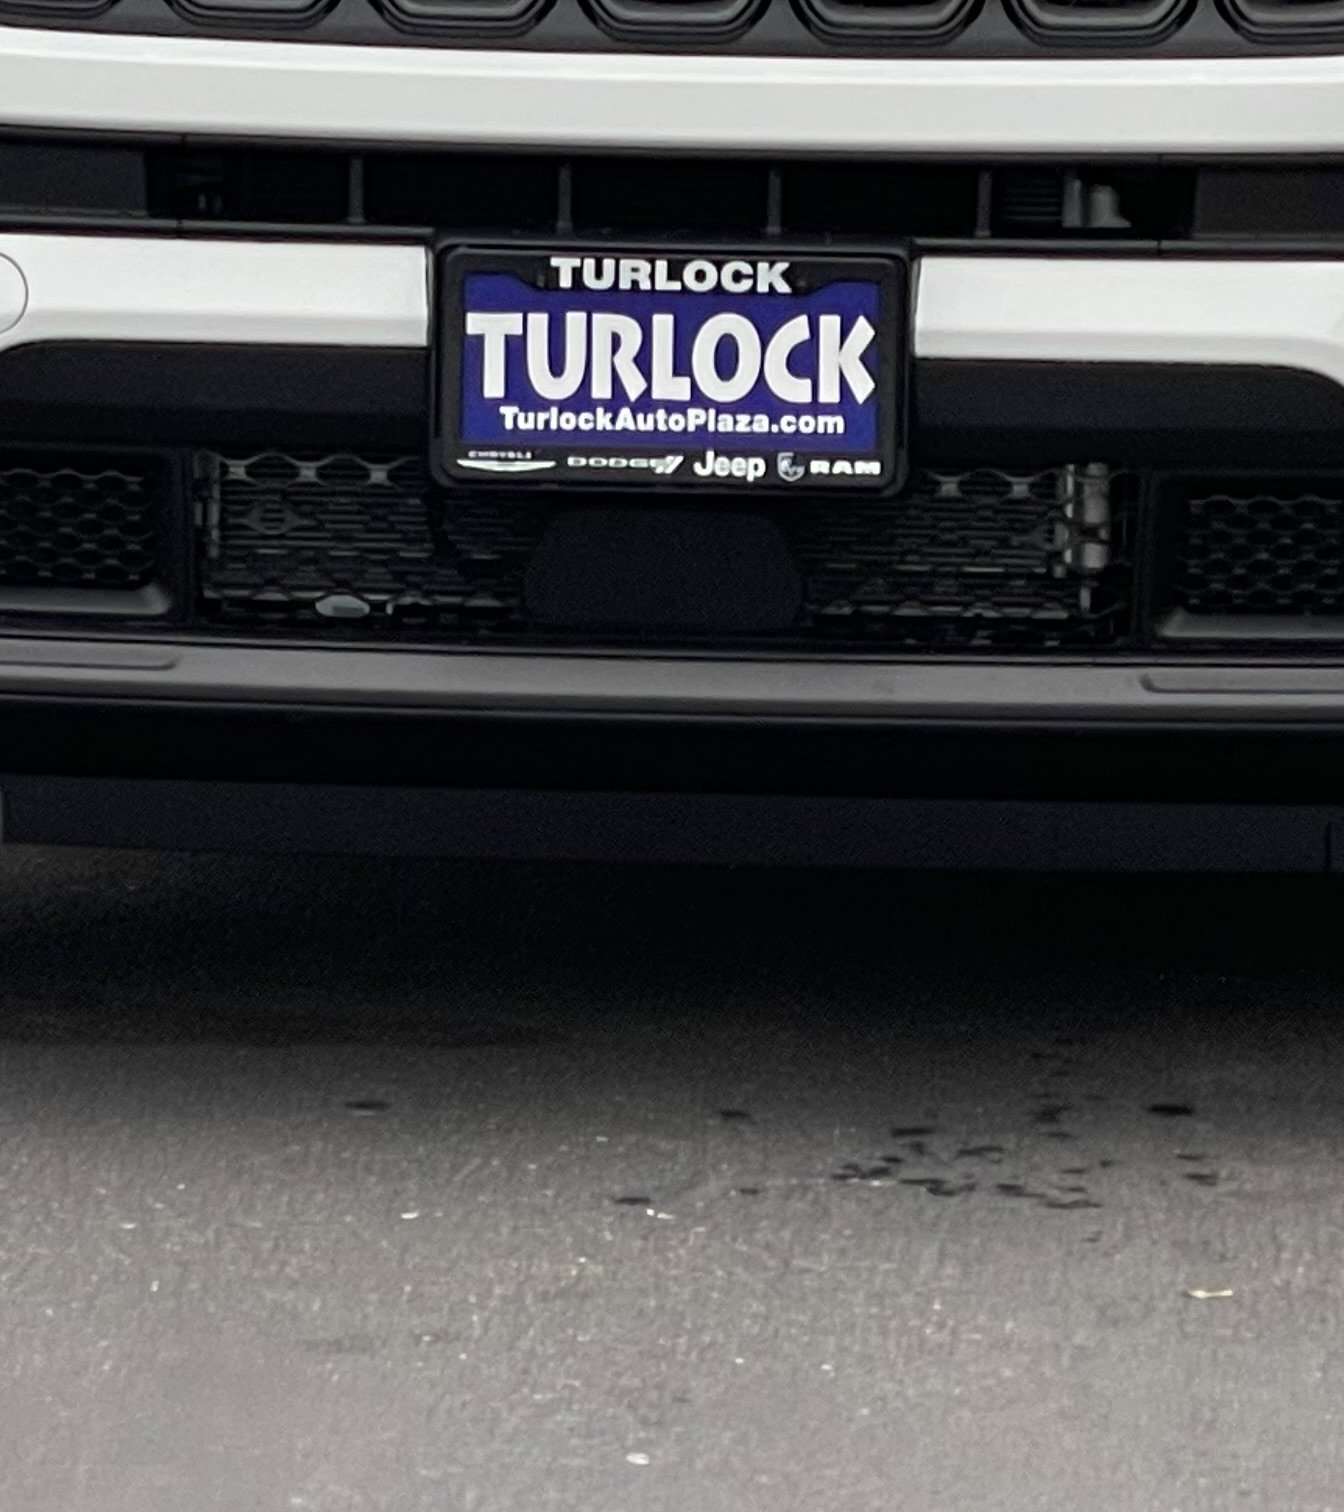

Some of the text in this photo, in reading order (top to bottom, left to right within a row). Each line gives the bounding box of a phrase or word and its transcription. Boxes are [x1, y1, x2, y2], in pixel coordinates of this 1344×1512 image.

[551, 257, 792, 294] TURLOCK
[465, 311, 876, 406] TURLOCK
[499, 406, 845, 434] TurlockAutoPlaza.com
[693, 449, 767, 483] Jeep
[809, 459, 882, 476] RAM
